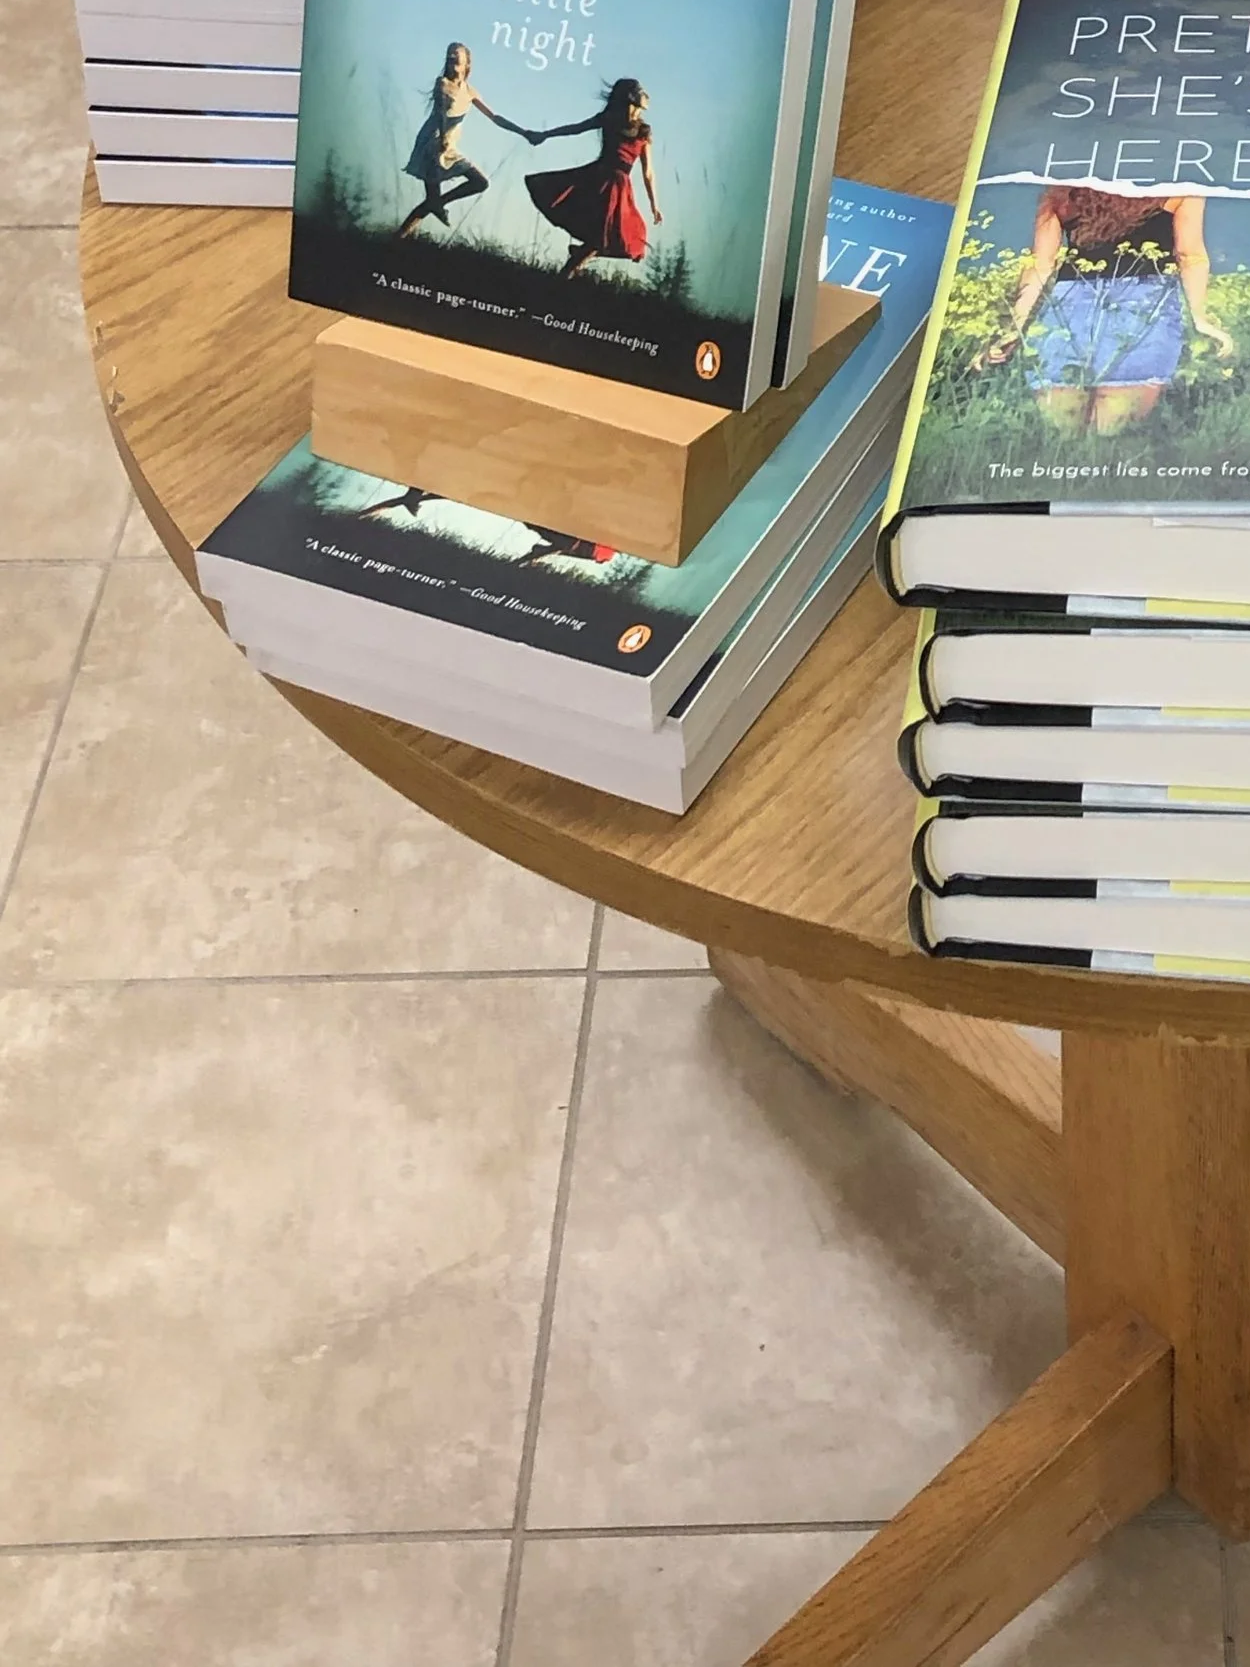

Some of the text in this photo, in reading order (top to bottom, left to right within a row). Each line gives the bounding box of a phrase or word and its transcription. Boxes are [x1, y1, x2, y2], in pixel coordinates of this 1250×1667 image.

[491, 18, 597, 71] night
[860, 205, 916, 223] author
[391, 276, 432, 298] classic
[578, 321, 659, 357] Housekeeping
[988, 463, 1025, 478] The
[1032, 462, 1109, 484] biggest
[1116, 461, 1149, 478] lies
[1157, 464, 1213, 478] come
[321, 544, 362, 563] classic
[505, 596, 587, 631] Housekeeping
